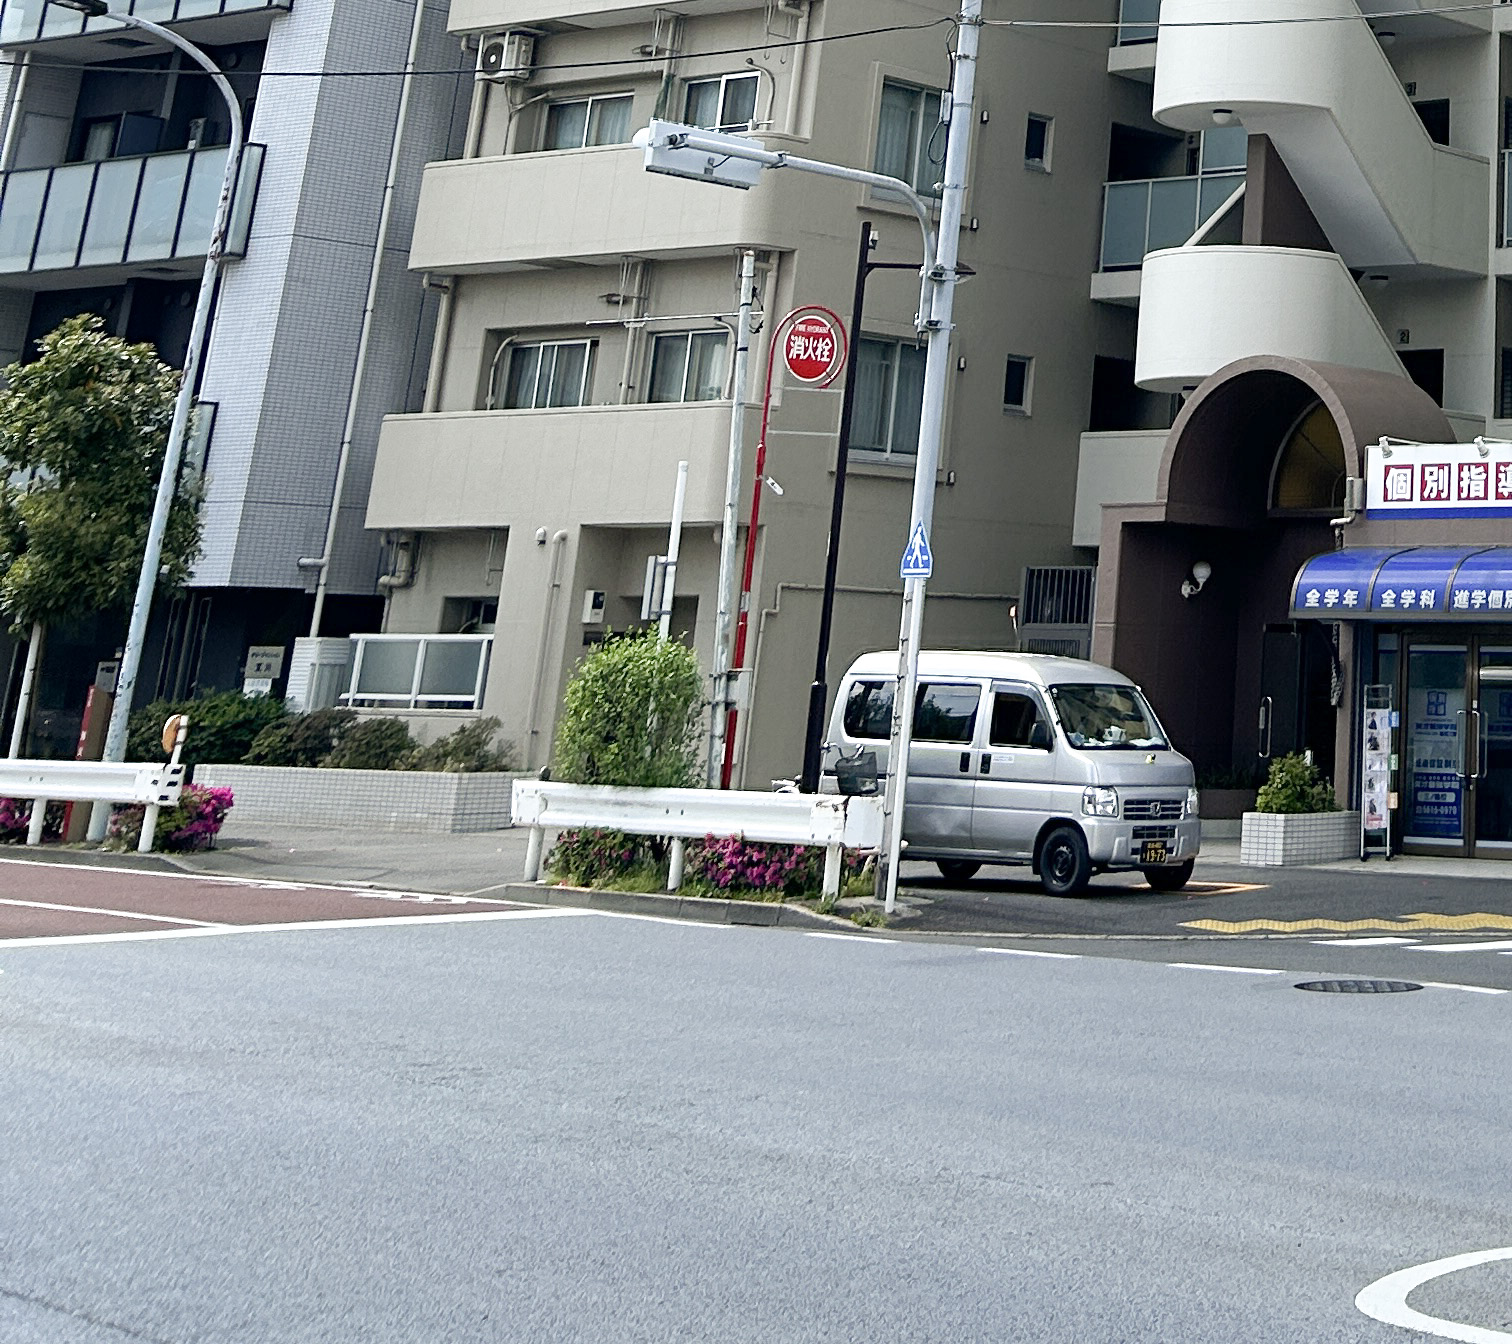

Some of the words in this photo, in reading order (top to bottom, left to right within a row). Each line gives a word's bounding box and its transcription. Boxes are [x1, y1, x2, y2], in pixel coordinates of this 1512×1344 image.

[789, 335, 832, 361] 消火栓
[1305, 589, 1358, 609] 全学年
[1380, 589, 1435, 609] 全学科
